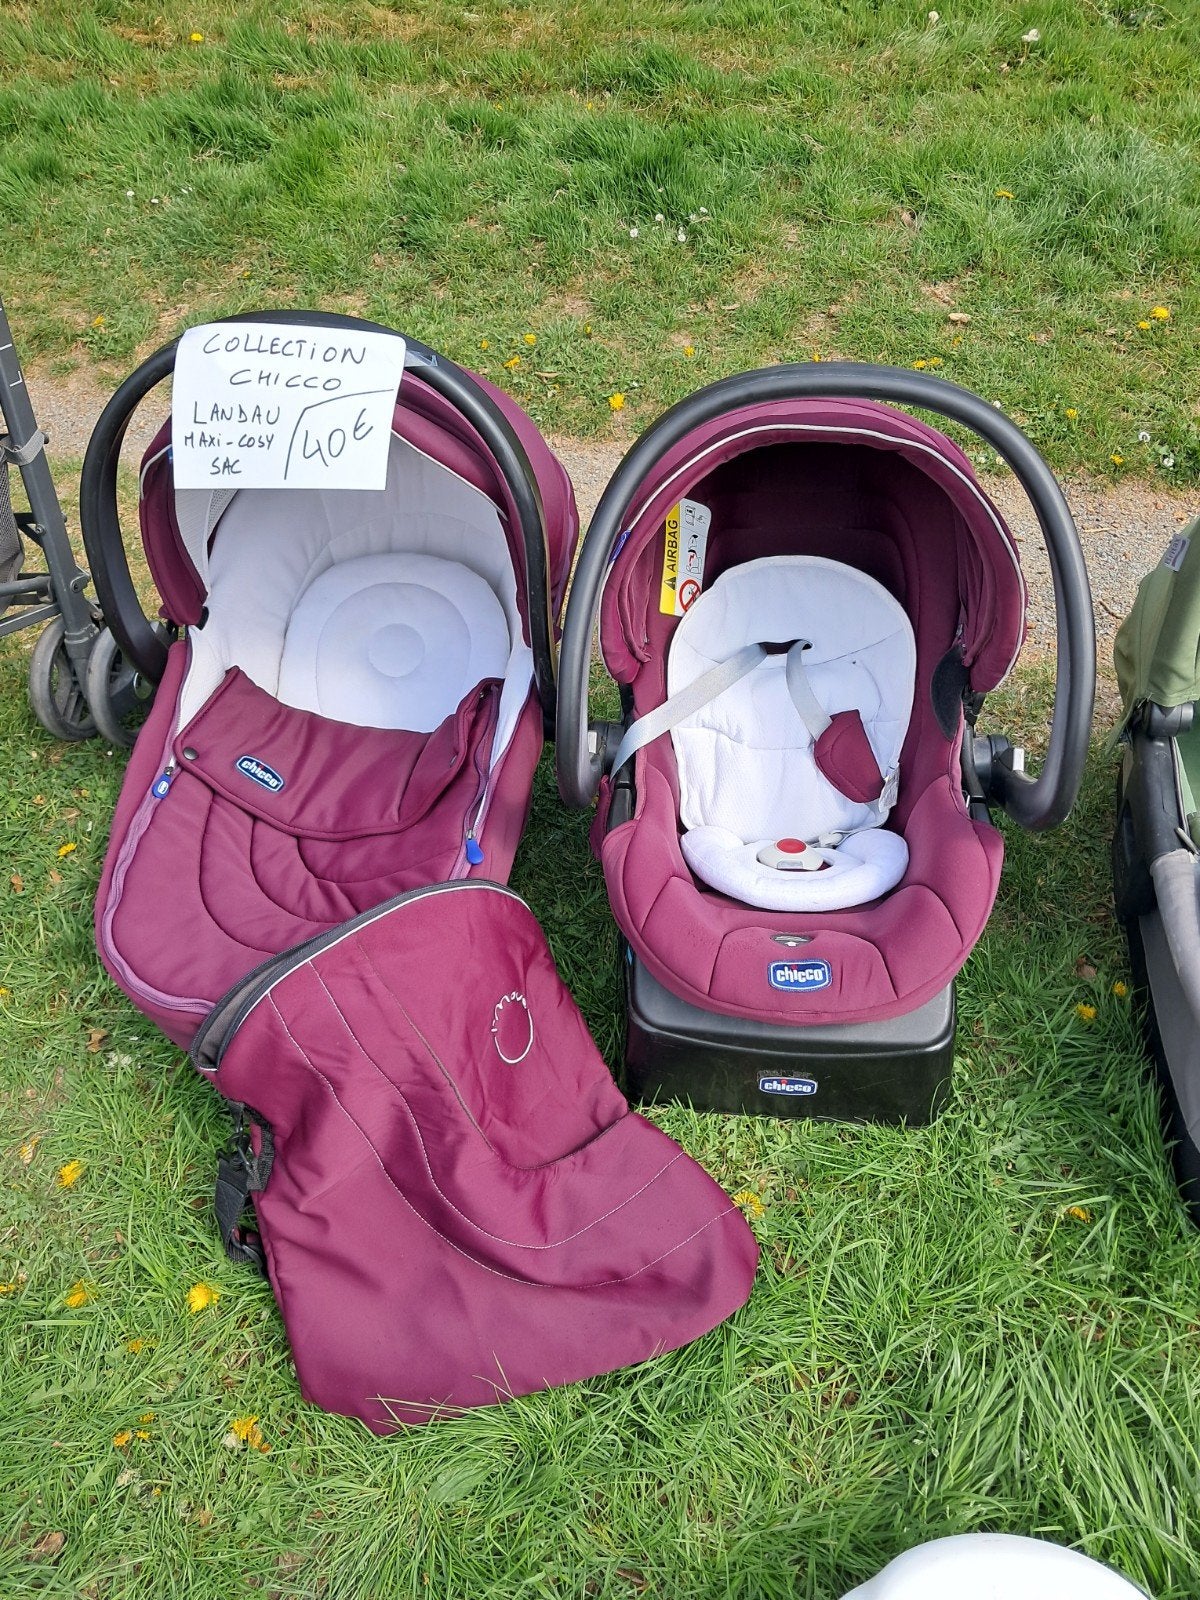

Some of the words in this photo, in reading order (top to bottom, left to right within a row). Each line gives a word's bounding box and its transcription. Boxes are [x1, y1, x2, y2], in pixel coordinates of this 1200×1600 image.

[229, 369, 341, 391] CHICCO
[193, 401, 280, 425] LANDAU
[209, 456, 242, 475] SAC
[667, 519, 679, 573] AIRBAG
[240, 759, 279, 788] chicco
[775, 964, 824, 983] chicco
[764, 1078, 812, 1093] chicco
